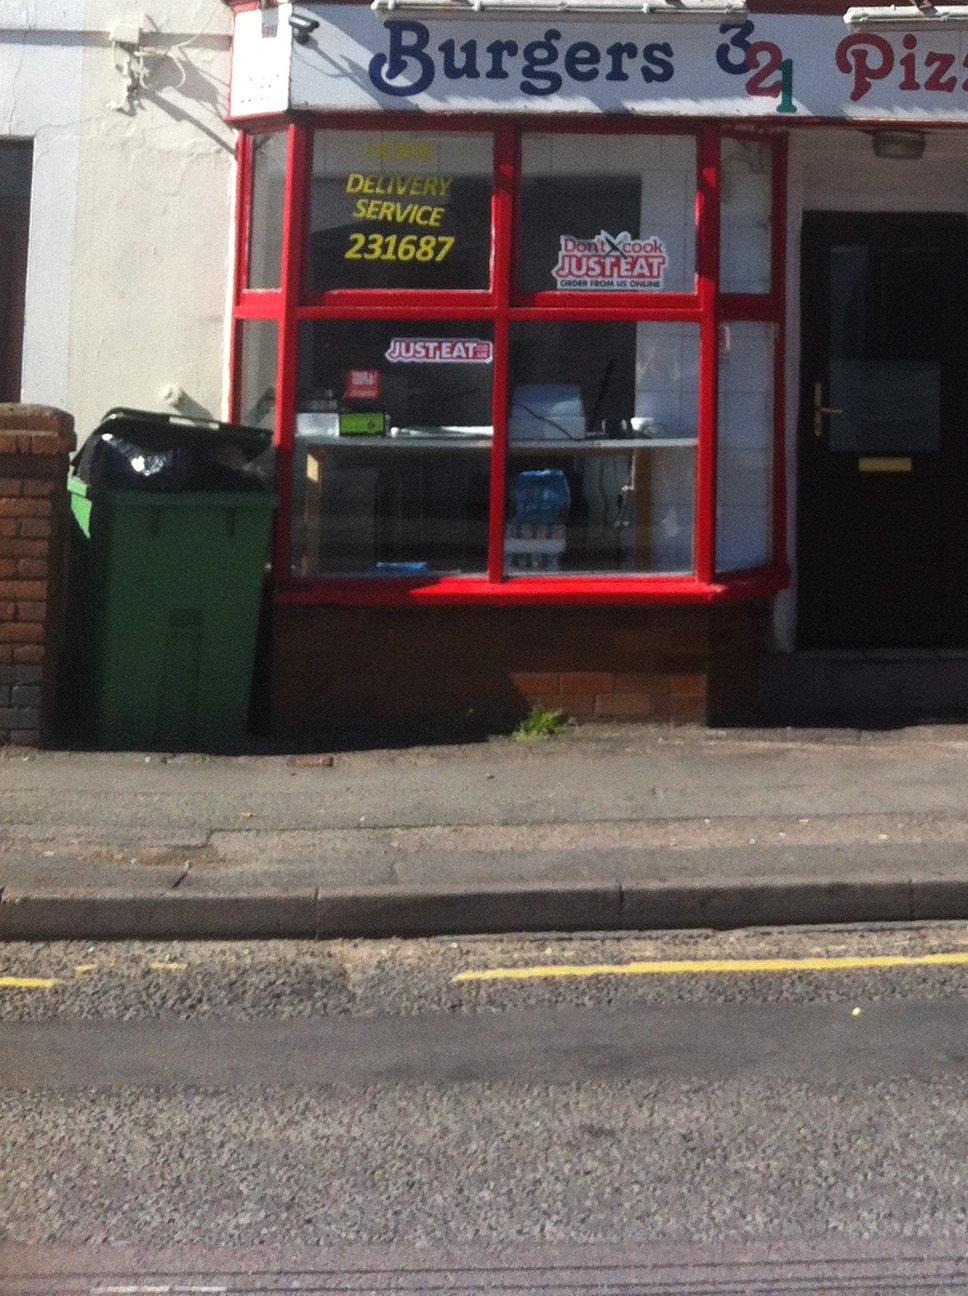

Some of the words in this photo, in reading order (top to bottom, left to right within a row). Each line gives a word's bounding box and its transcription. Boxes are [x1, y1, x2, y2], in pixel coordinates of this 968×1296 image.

[369, 19, 674, 97] Burgers
[345, 173, 453, 197] DELIVERY
[353, 198, 446, 227] SERVICE
[344, 232, 456, 262] 231687
[622, 240, 663, 254] cook
[560, 279, 588, 288] ORDER
[590, 279, 616, 288] FROM
